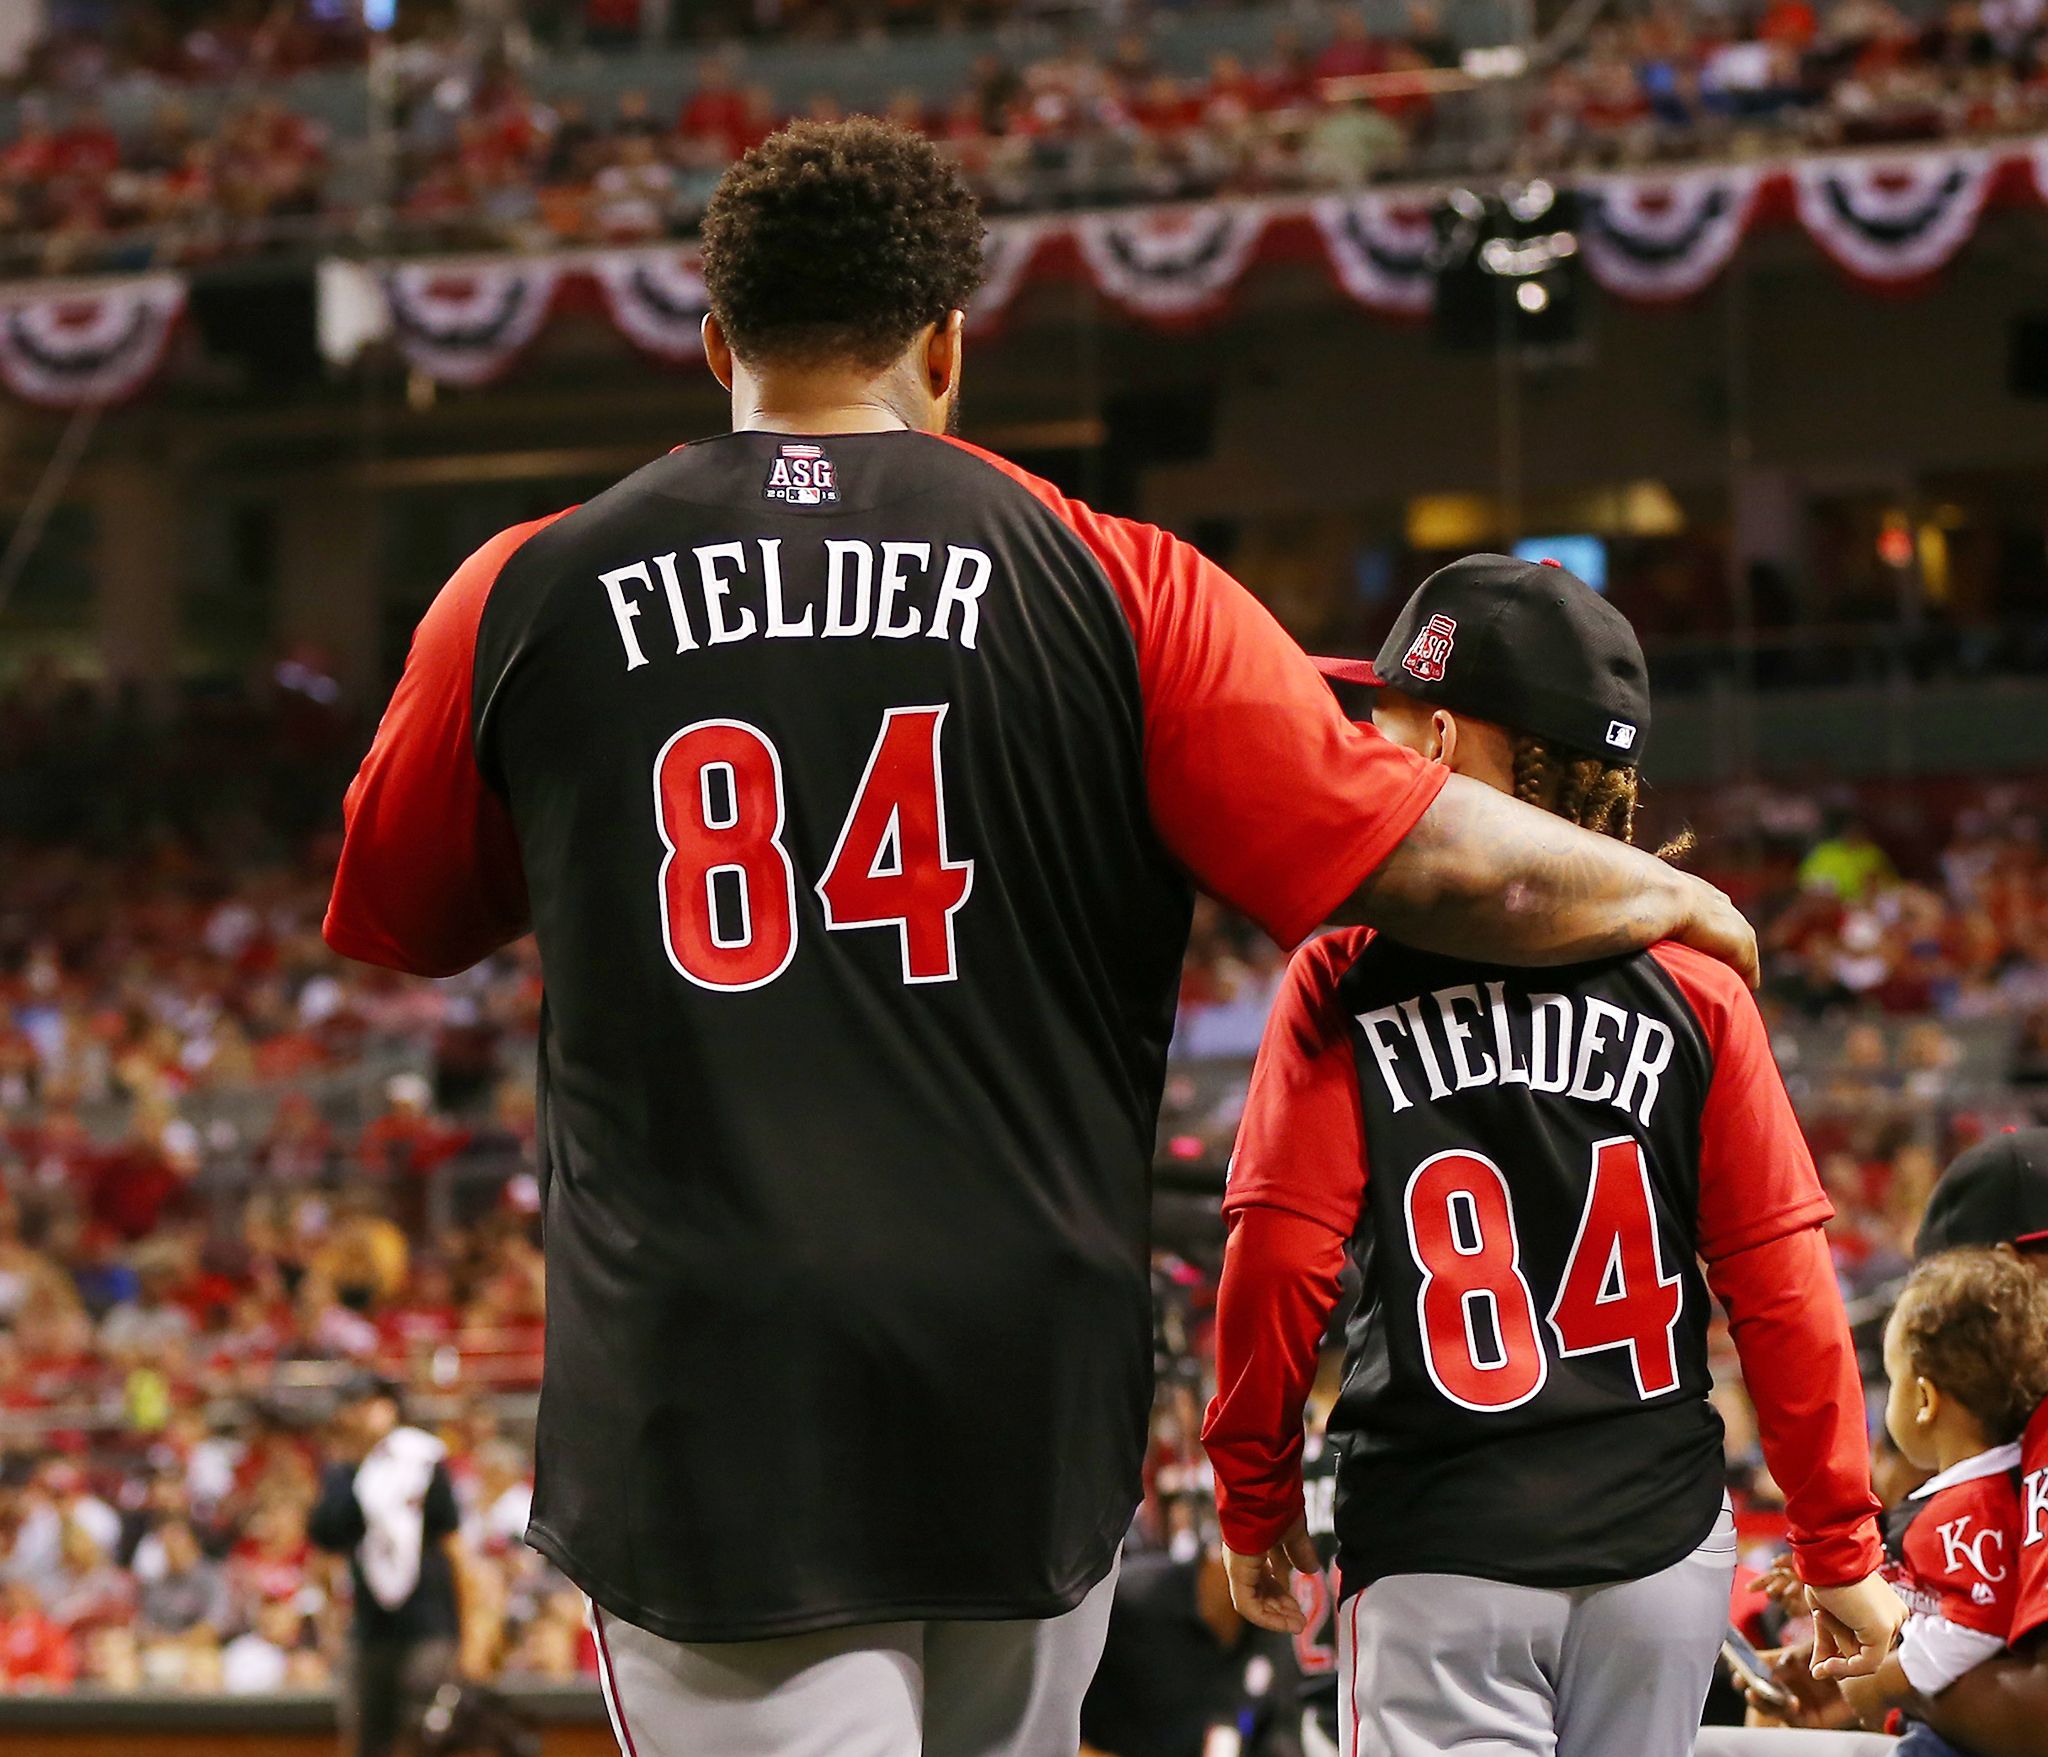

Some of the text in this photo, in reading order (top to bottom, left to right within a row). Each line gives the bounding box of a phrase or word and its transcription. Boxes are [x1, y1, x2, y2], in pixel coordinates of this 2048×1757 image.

[769, 458, 833, 488] ASG
[598, 538, 992, 671] FIELDER
[1411, 631, 1449, 665] ASG
[653, 703, 974, 992] 84
[1355, 981, 1675, 1128] FIELDER
[1404, 1135, 1683, 1412] 84
[1936, 1515, 2006, 1582] KC
[1290, 1556, 1342, 1678] 2
